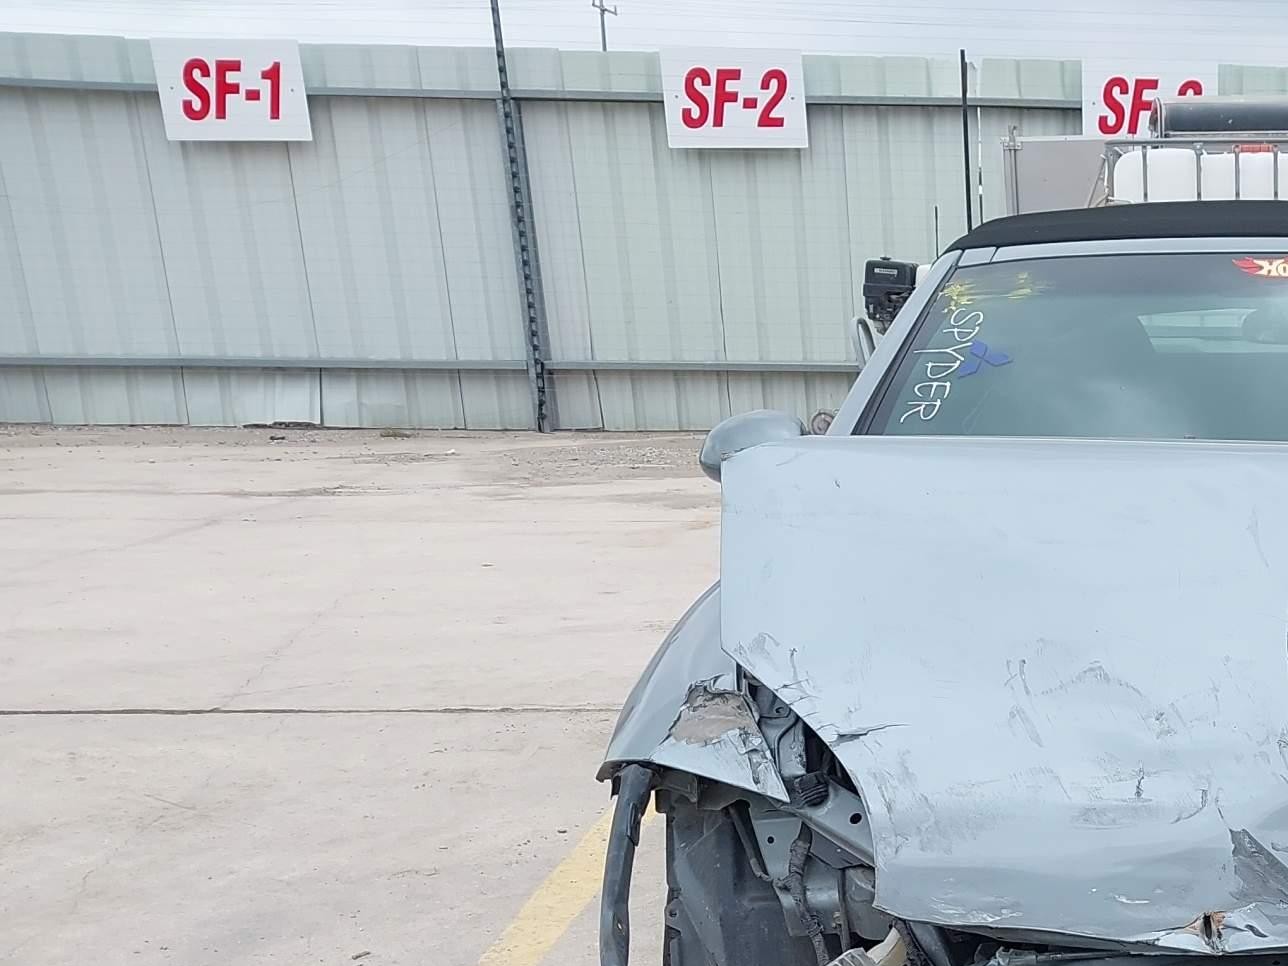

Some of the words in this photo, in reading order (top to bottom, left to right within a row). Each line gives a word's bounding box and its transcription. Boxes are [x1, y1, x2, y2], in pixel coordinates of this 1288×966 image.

[182, 58, 281, 121] SF-1
[681, 66, 788, 129] SF-2
[900, 307, 984, 424] SPYDER
